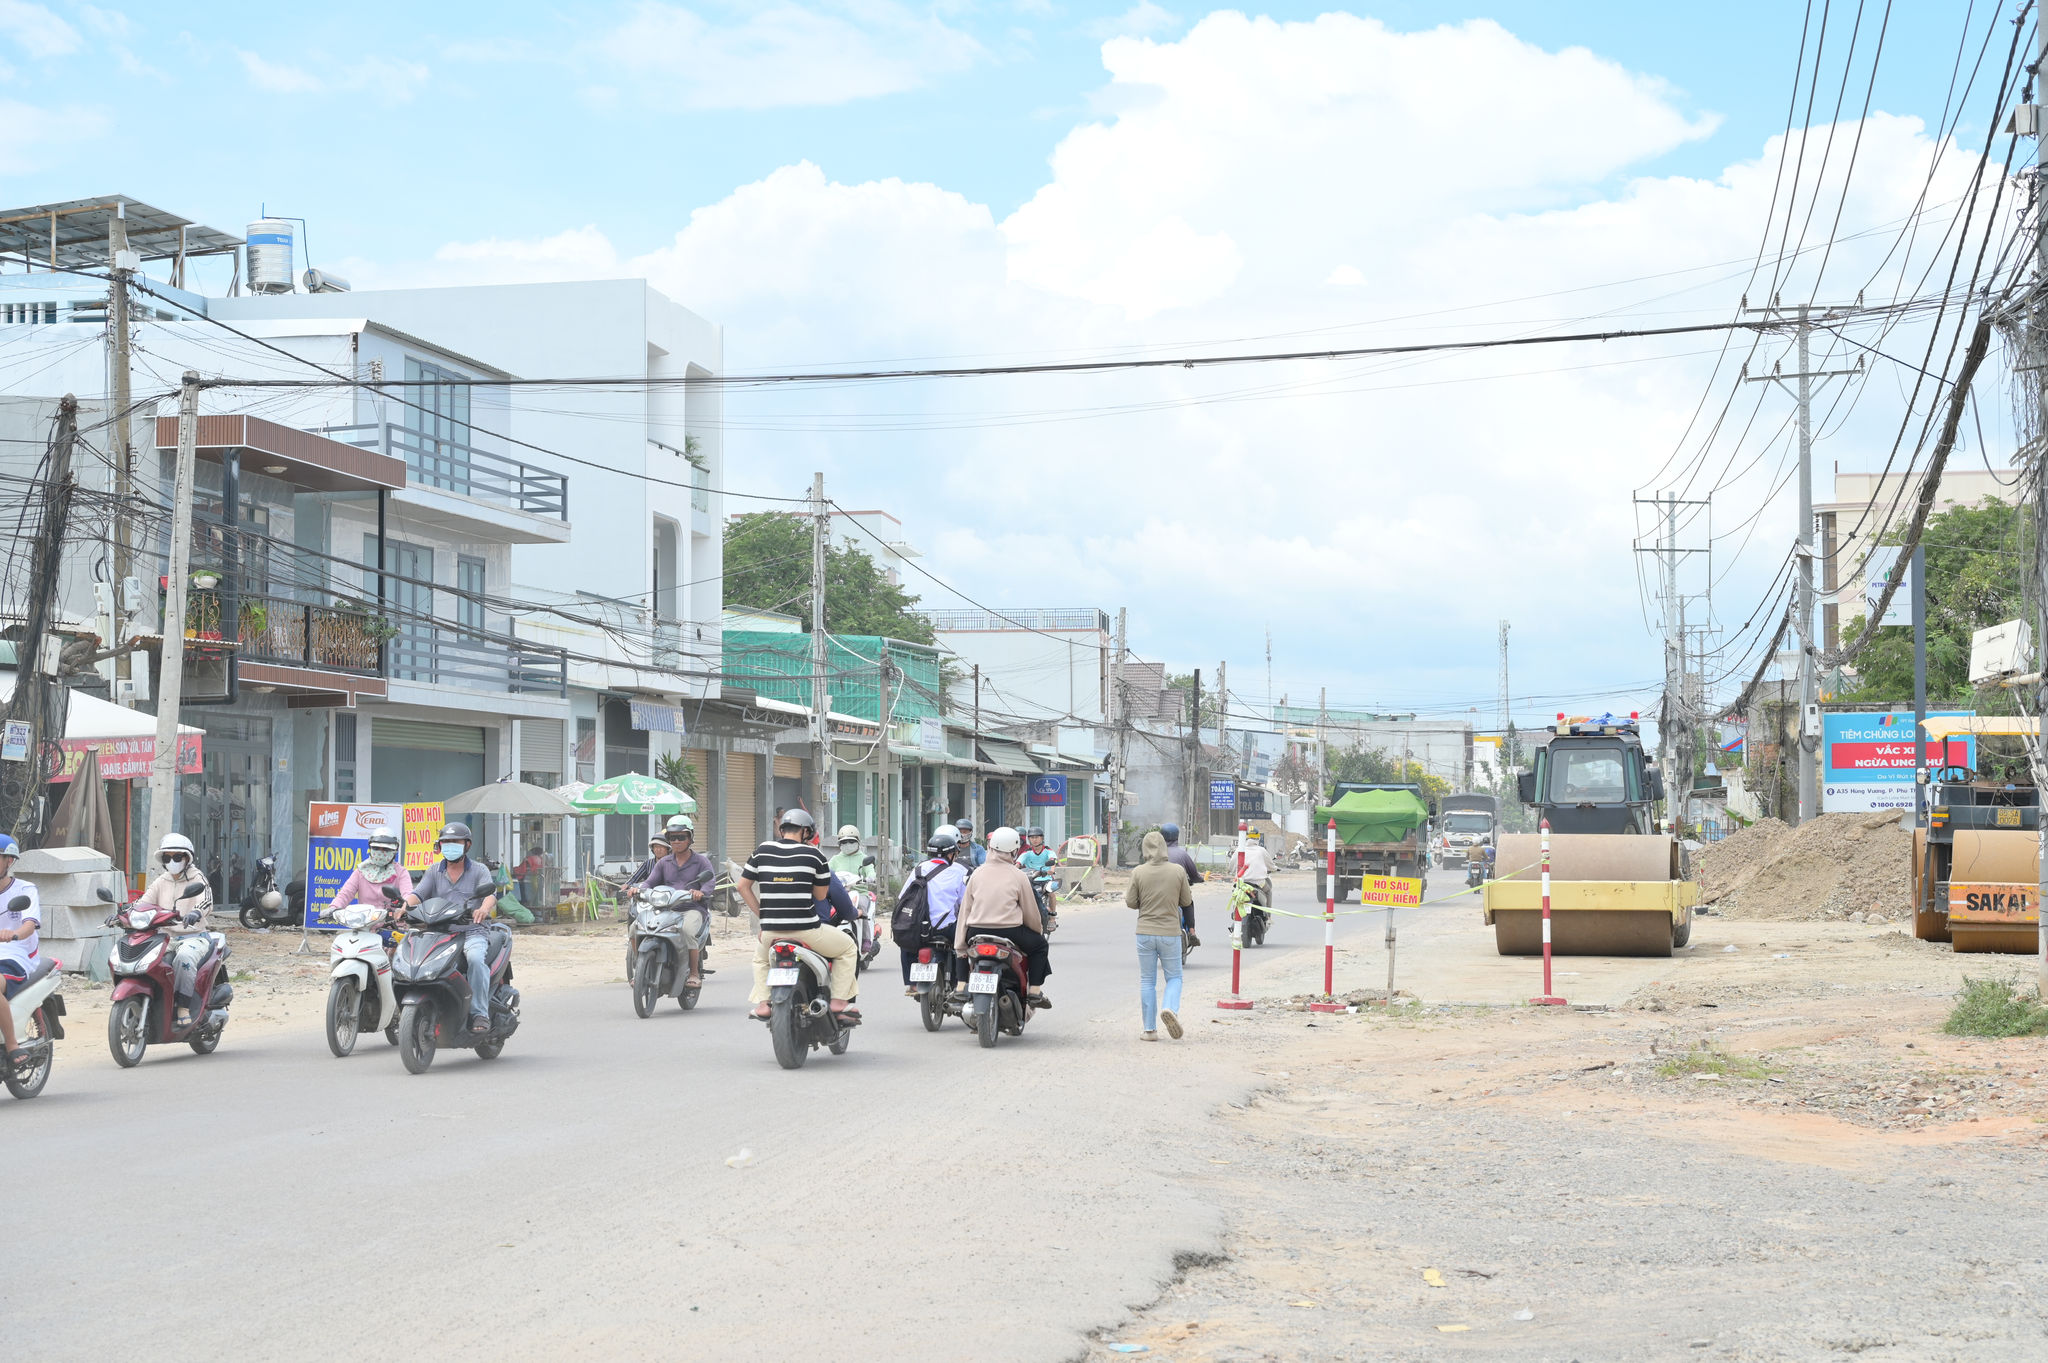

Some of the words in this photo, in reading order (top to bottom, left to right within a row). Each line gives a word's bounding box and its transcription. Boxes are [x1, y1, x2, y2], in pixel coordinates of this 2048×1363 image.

[1840, 728, 1861, 739] TIÊM
[1864, 728, 1899, 739] CHỦNG
[1855, 757, 1889, 767] NGỪA
[1926, 758, 1944, 767] HƯ
[405, 807, 424, 822] BƠM
[426, 805, 441, 821] HƠI
[314, 847, 362, 870] HONDA
[407, 852, 421, 866] TAY
[424, 851, 433, 866] GA
[1374, 877, 1387, 890] HỐ
[1390, 879, 1409, 891] SÂU
[1364, 892, 1390, 902] NGUY
[1393, 891, 1418, 904] HIỂM
[1966, 893, 2027, 912] SAKAI
